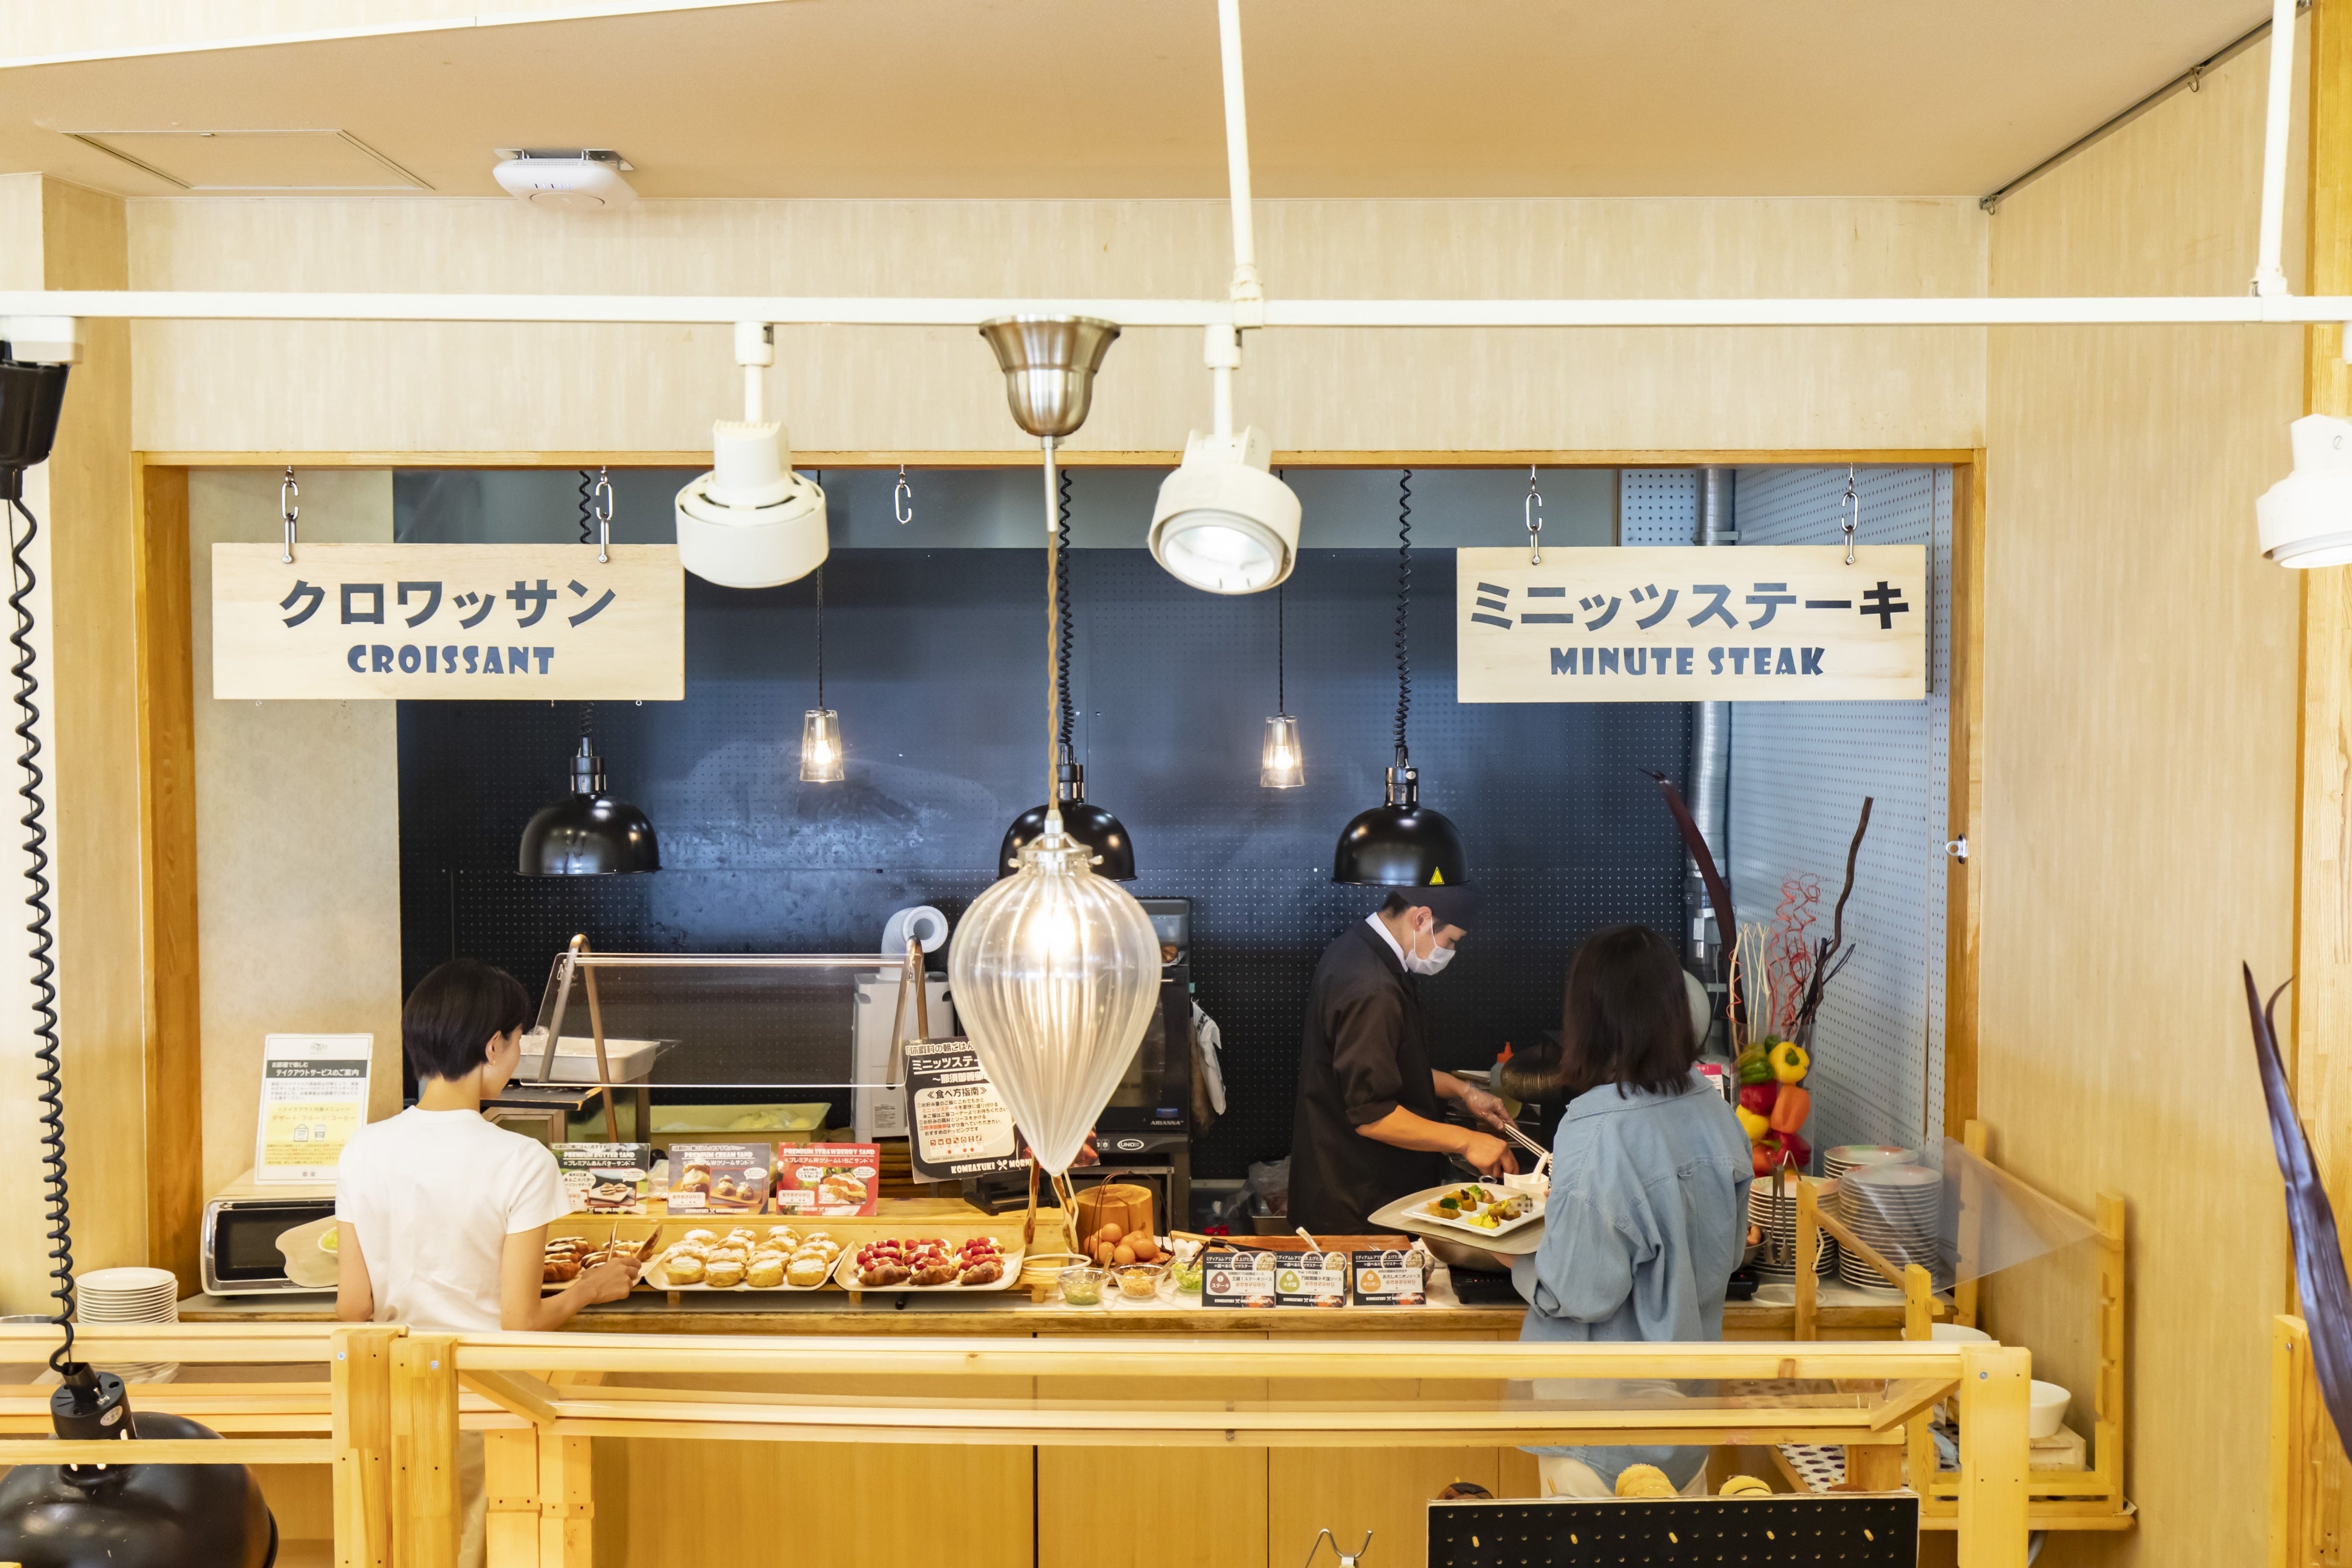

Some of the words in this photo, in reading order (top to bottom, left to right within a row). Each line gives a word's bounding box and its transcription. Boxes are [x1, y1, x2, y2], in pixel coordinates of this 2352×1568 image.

[279, 579, 616, 629] クロワッサン
[1470, 581, 1909, 631] ミニッツステーキ
[347, 644, 555, 675] CROISSANT
[1550, 647, 1693, 675] MINUTE
[1710, 647, 1826, 675] STEAK
[927, 1087, 987, 1099] 《食べ方指南》
[950, 1162, 995, 1174] KOMEAZUKI
